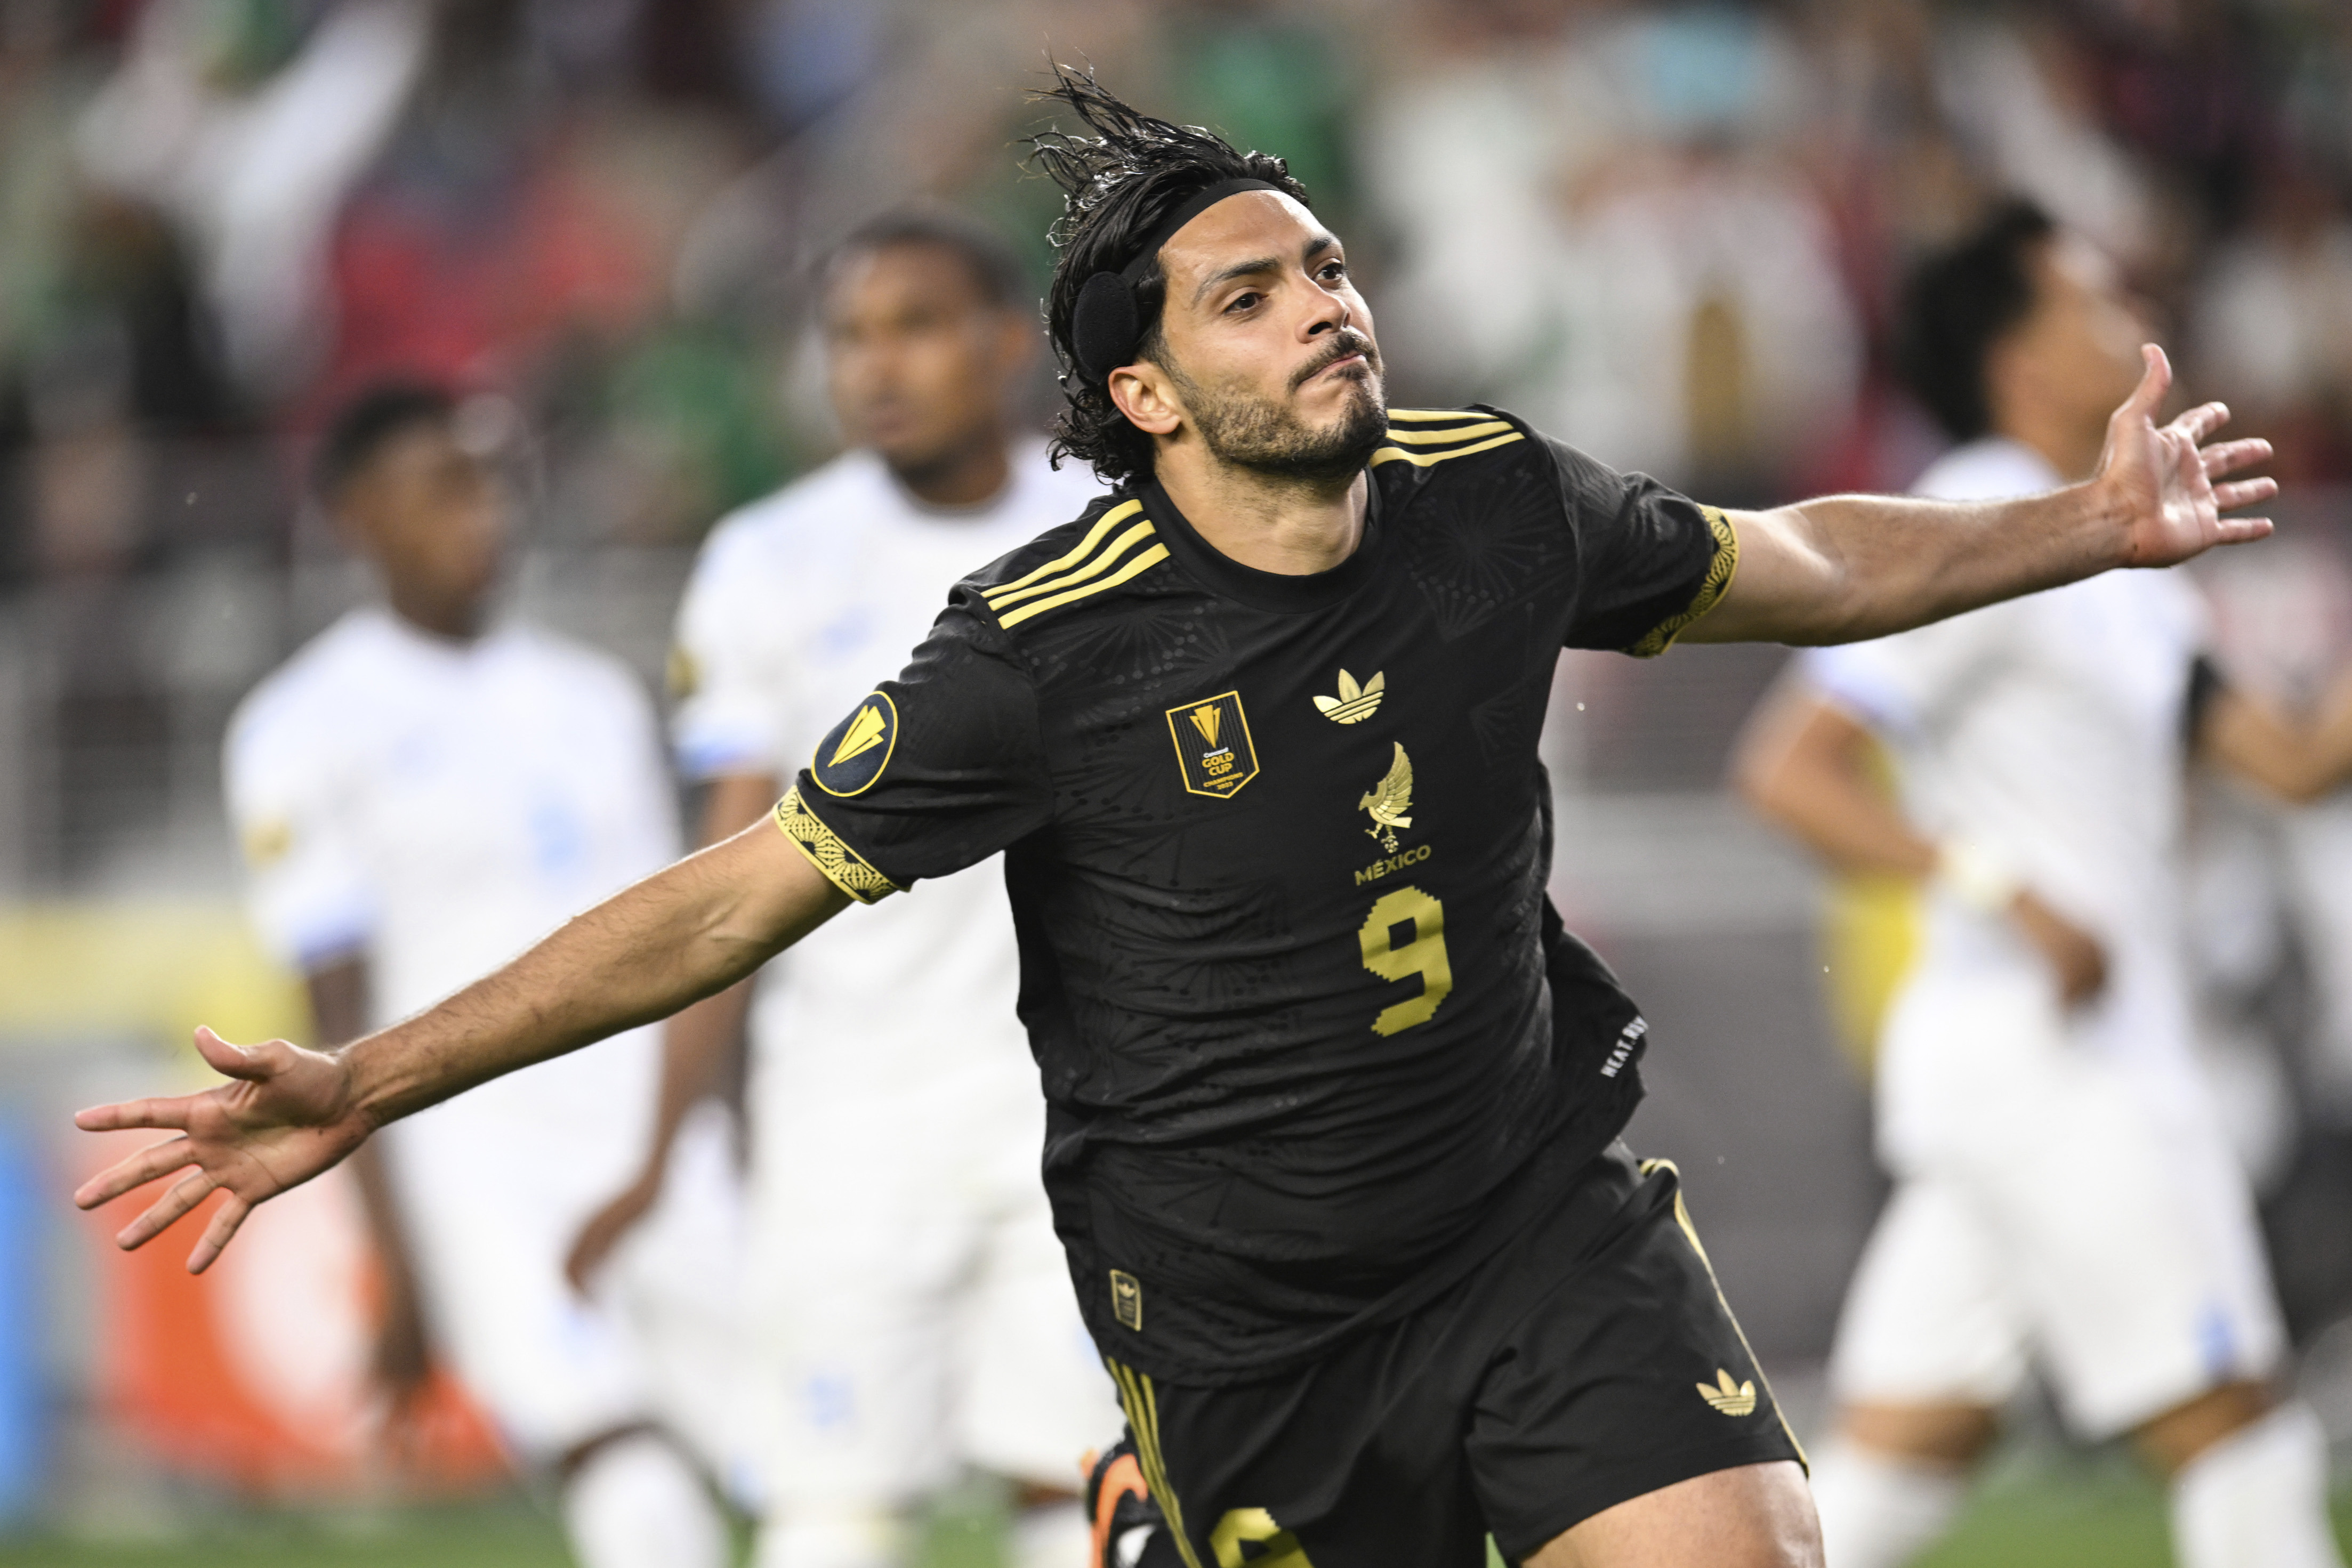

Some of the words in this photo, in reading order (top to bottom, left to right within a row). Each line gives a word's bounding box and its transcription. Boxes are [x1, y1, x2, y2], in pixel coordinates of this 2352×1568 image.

[1202, 752, 1235, 768] GOLD
[1208, 762, 1233, 776] CUP
[1354, 845, 1431, 886] MÉXICO
[1358, 885, 1453, 1038] 9
